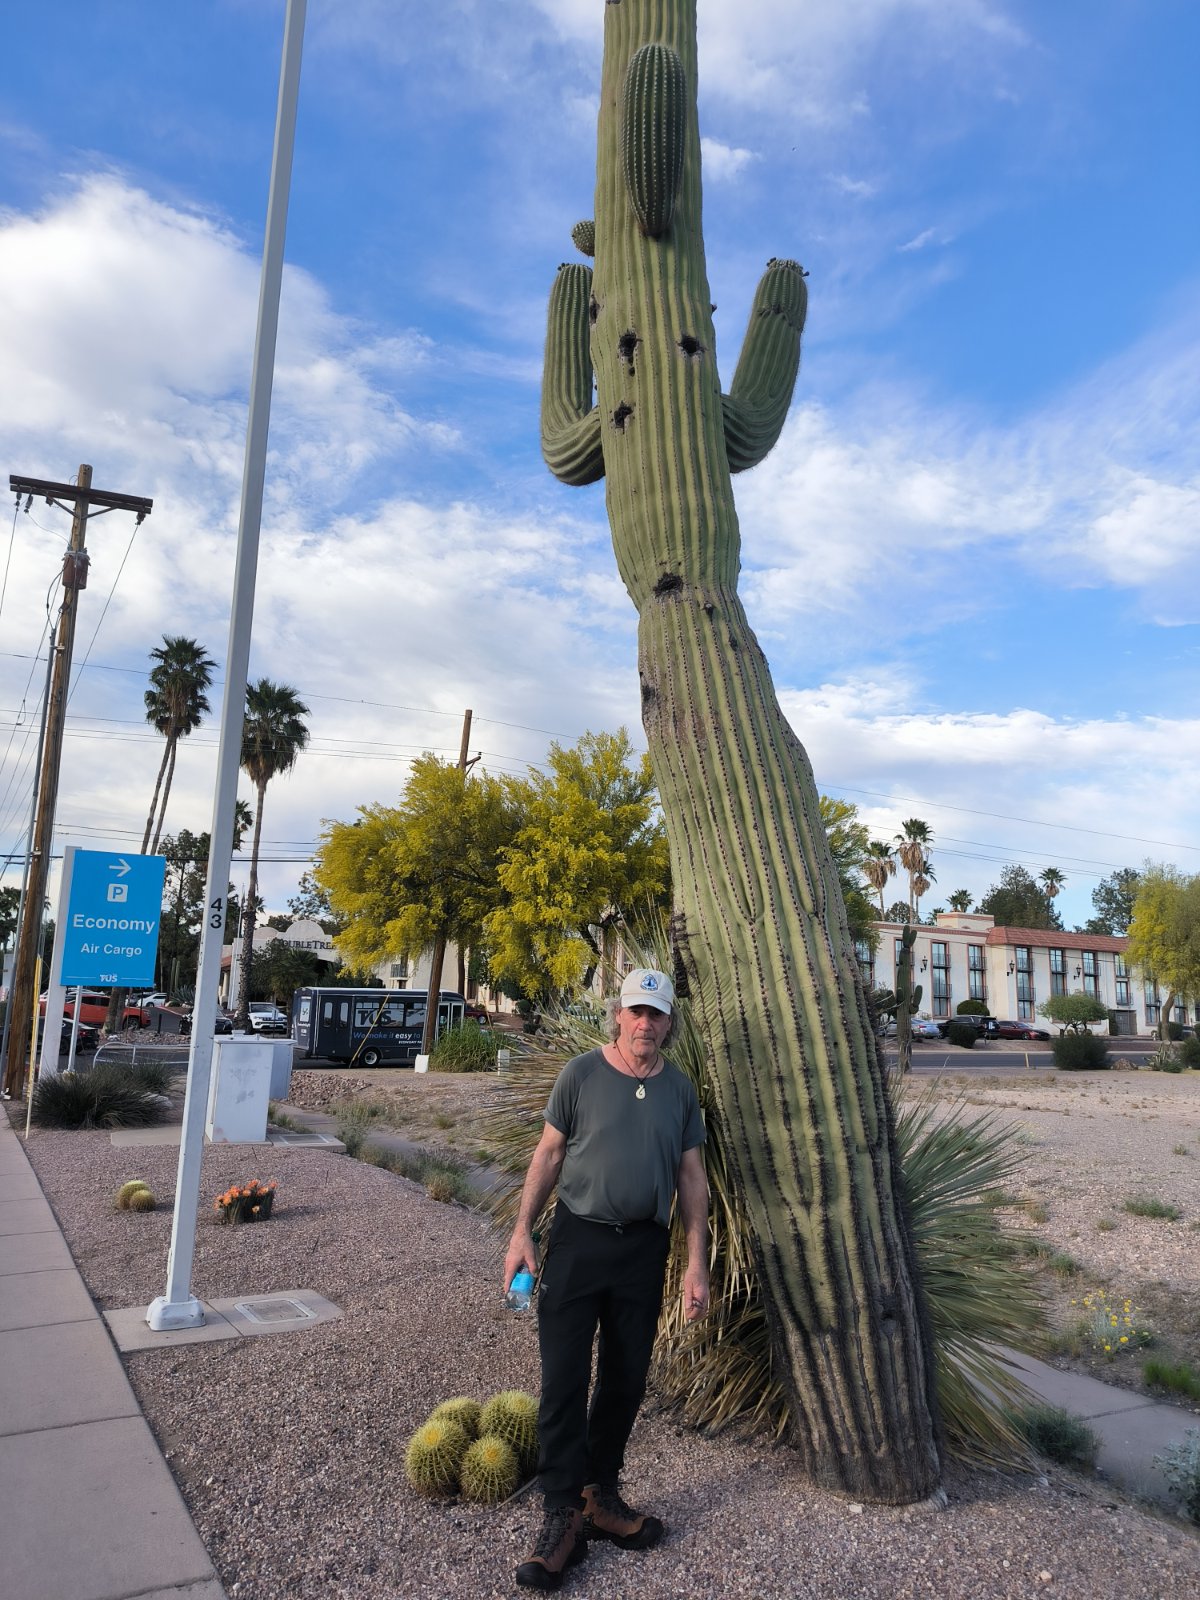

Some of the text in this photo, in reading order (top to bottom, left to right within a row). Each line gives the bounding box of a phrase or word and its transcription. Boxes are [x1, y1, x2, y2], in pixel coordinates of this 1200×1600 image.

[112, 886, 124, 899] P
[73, 914, 155, 934] Economy
[80, 943, 142, 958] Air Cargo
[100, 974, 118, 983] TUS
[367, 1031, 387, 1039] make
[395, 1032, 413, 1040] easy
